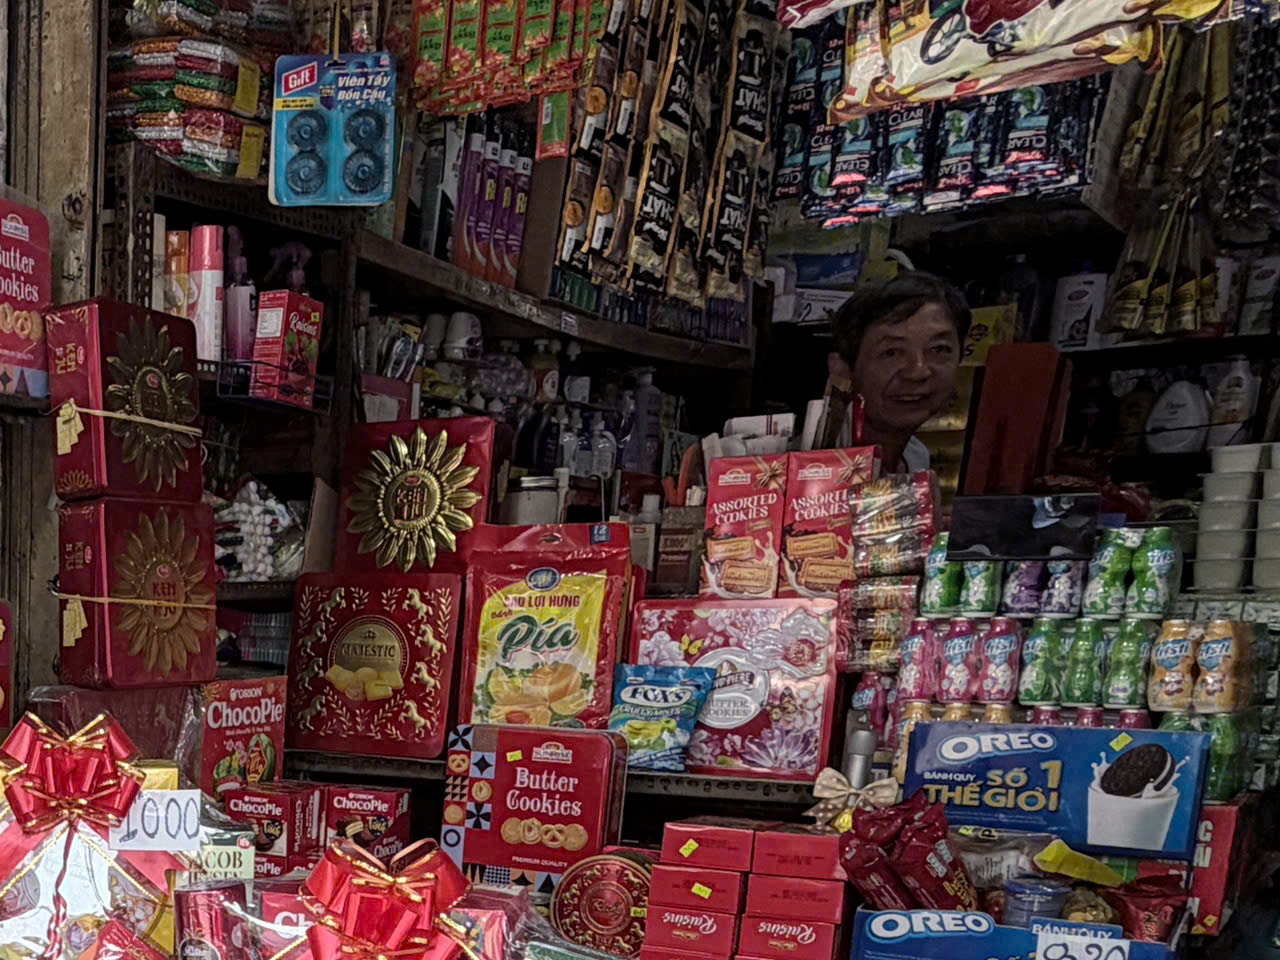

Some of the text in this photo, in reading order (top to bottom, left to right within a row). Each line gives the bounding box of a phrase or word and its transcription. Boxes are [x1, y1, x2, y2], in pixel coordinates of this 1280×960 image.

[710, 492, 778, 515] ASSORTED
[788, 489, 849, 512] ASSORT
[715, 505, 769, 527] COOKIES
[342, 643, 396, 659] MAJESTIC
[628, 685, 688, 702] FOX'S
[206, 698, 283, 729] ChocoPie
[939, 731, 1056, 761] OREO
[515, 767, 579, 794] Butter
[1039, 760, 1063, 789] 1
[230, 800, 283, 816] ChocoPie
[333, 796, 391, 813] ChocoPie
[505, 789, 582, 817] Cookies
[663, 911, 717, 934] Raisins
[759, 921, 816, 944] Raisins
[869, 911, 993, 938] OREO
